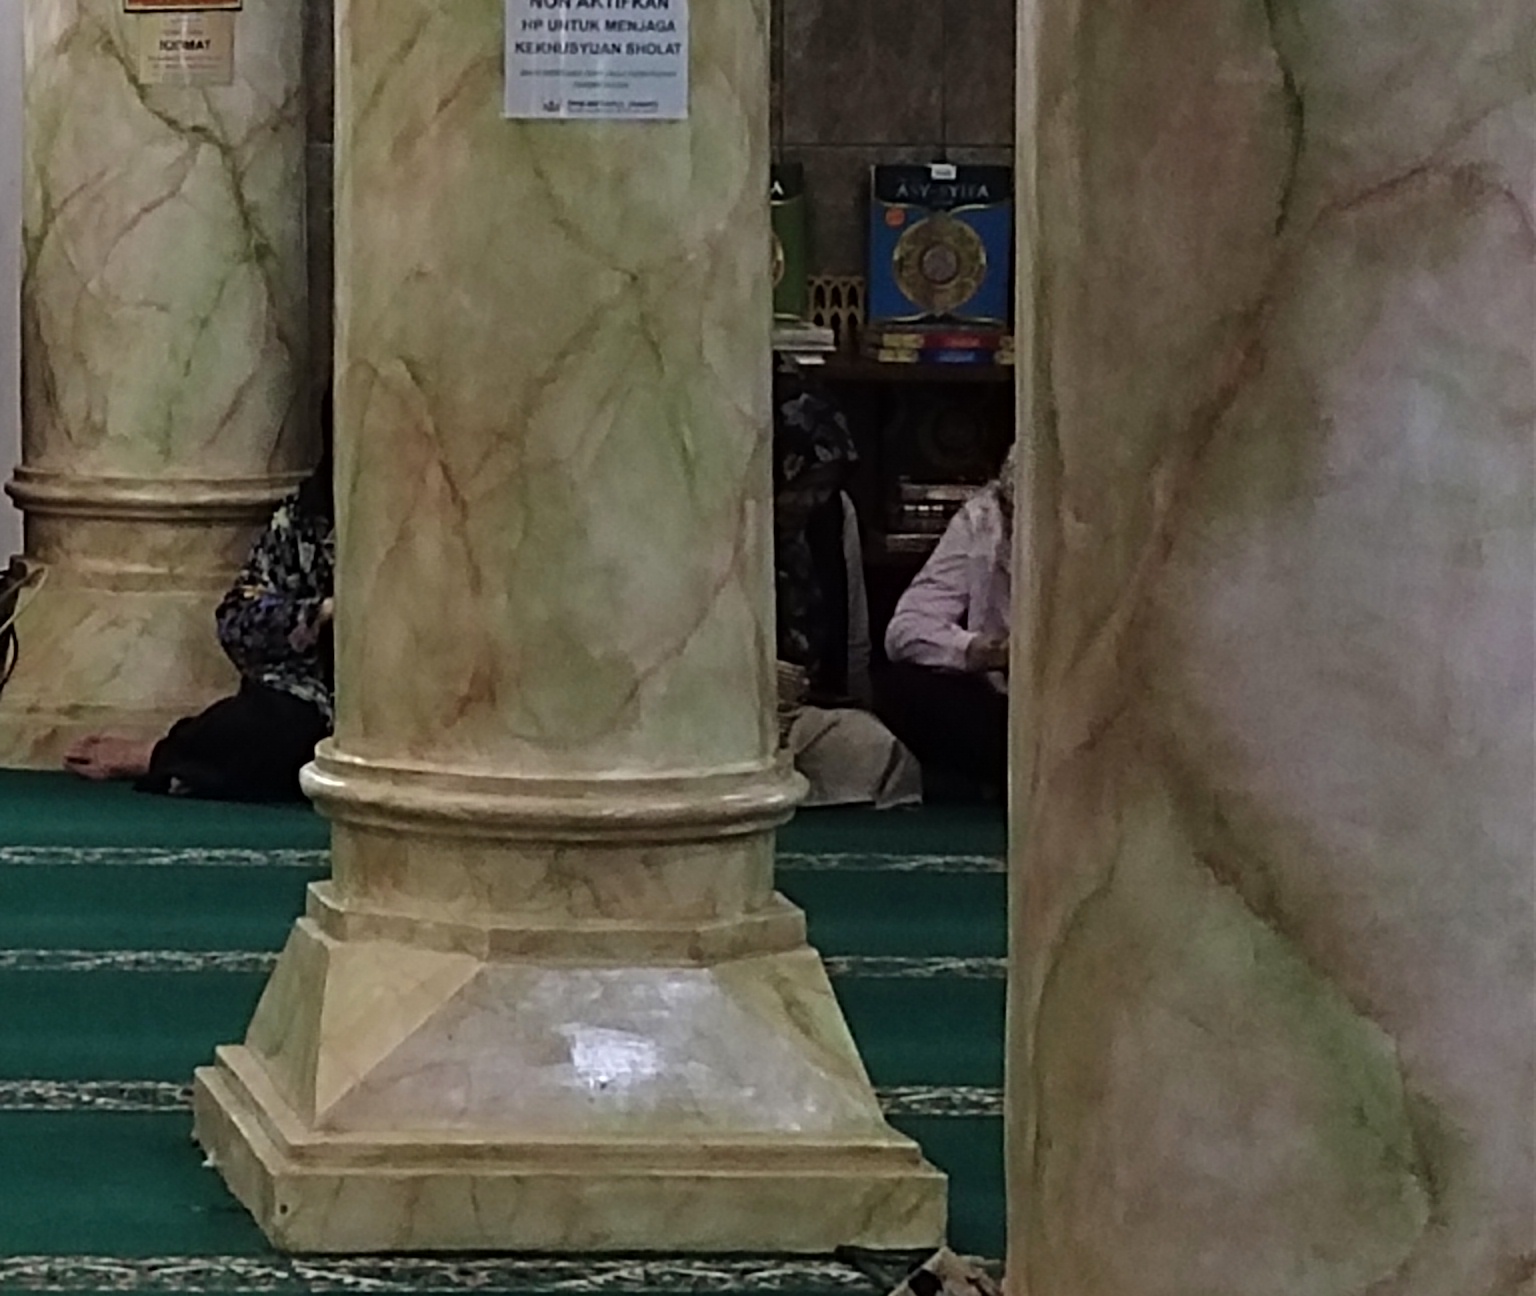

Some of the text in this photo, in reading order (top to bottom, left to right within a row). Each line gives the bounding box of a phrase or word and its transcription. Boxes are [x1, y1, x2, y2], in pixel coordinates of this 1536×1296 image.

[521, 19, 676, 33] HP UNTUK MENJAGA
[514, 41, 682, 55] KEKHUSYUAN SHOLAT
